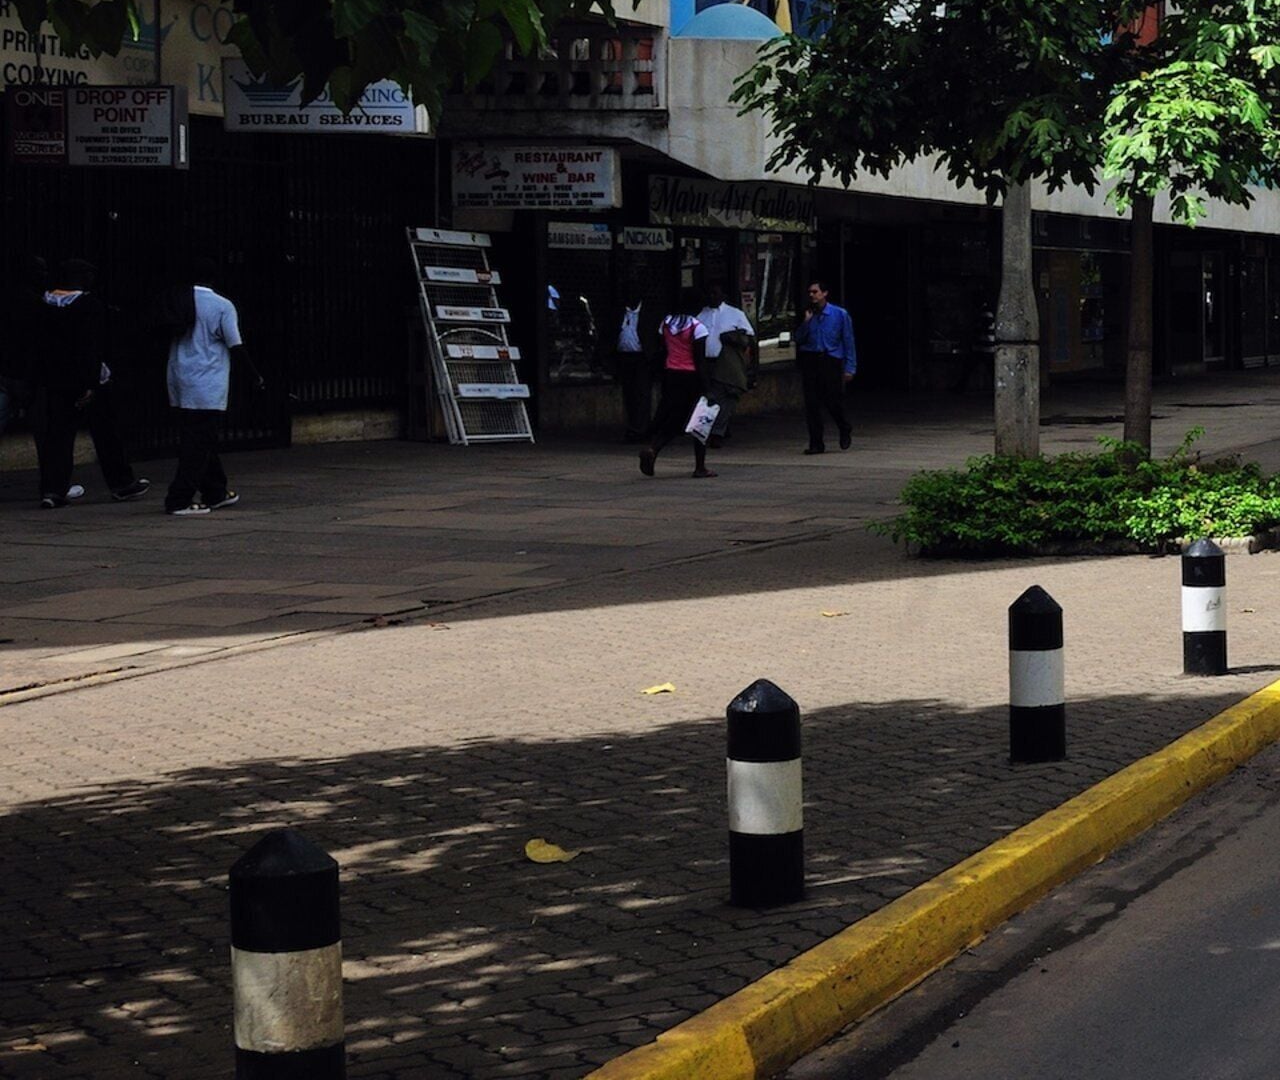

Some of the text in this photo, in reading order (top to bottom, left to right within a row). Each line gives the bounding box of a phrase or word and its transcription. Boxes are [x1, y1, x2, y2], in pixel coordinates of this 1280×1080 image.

[15, 91, 65, 107] ONE
[76, 91, 168, 105] DROP OFF
[94, 108, 148, 122] POINT
[240, 114, 403, 125] BUREAU SERVICES
[15, 145, 64, 153] COURIER
[514, 152, 603, 163] RESTAURANT
[556, 163, 567, 173] &
[522, 173, 596, 183] WINE BAR
[547, 233, 586, 245] SAMSUNG
[625, 231, 664, 246] NOKIA
